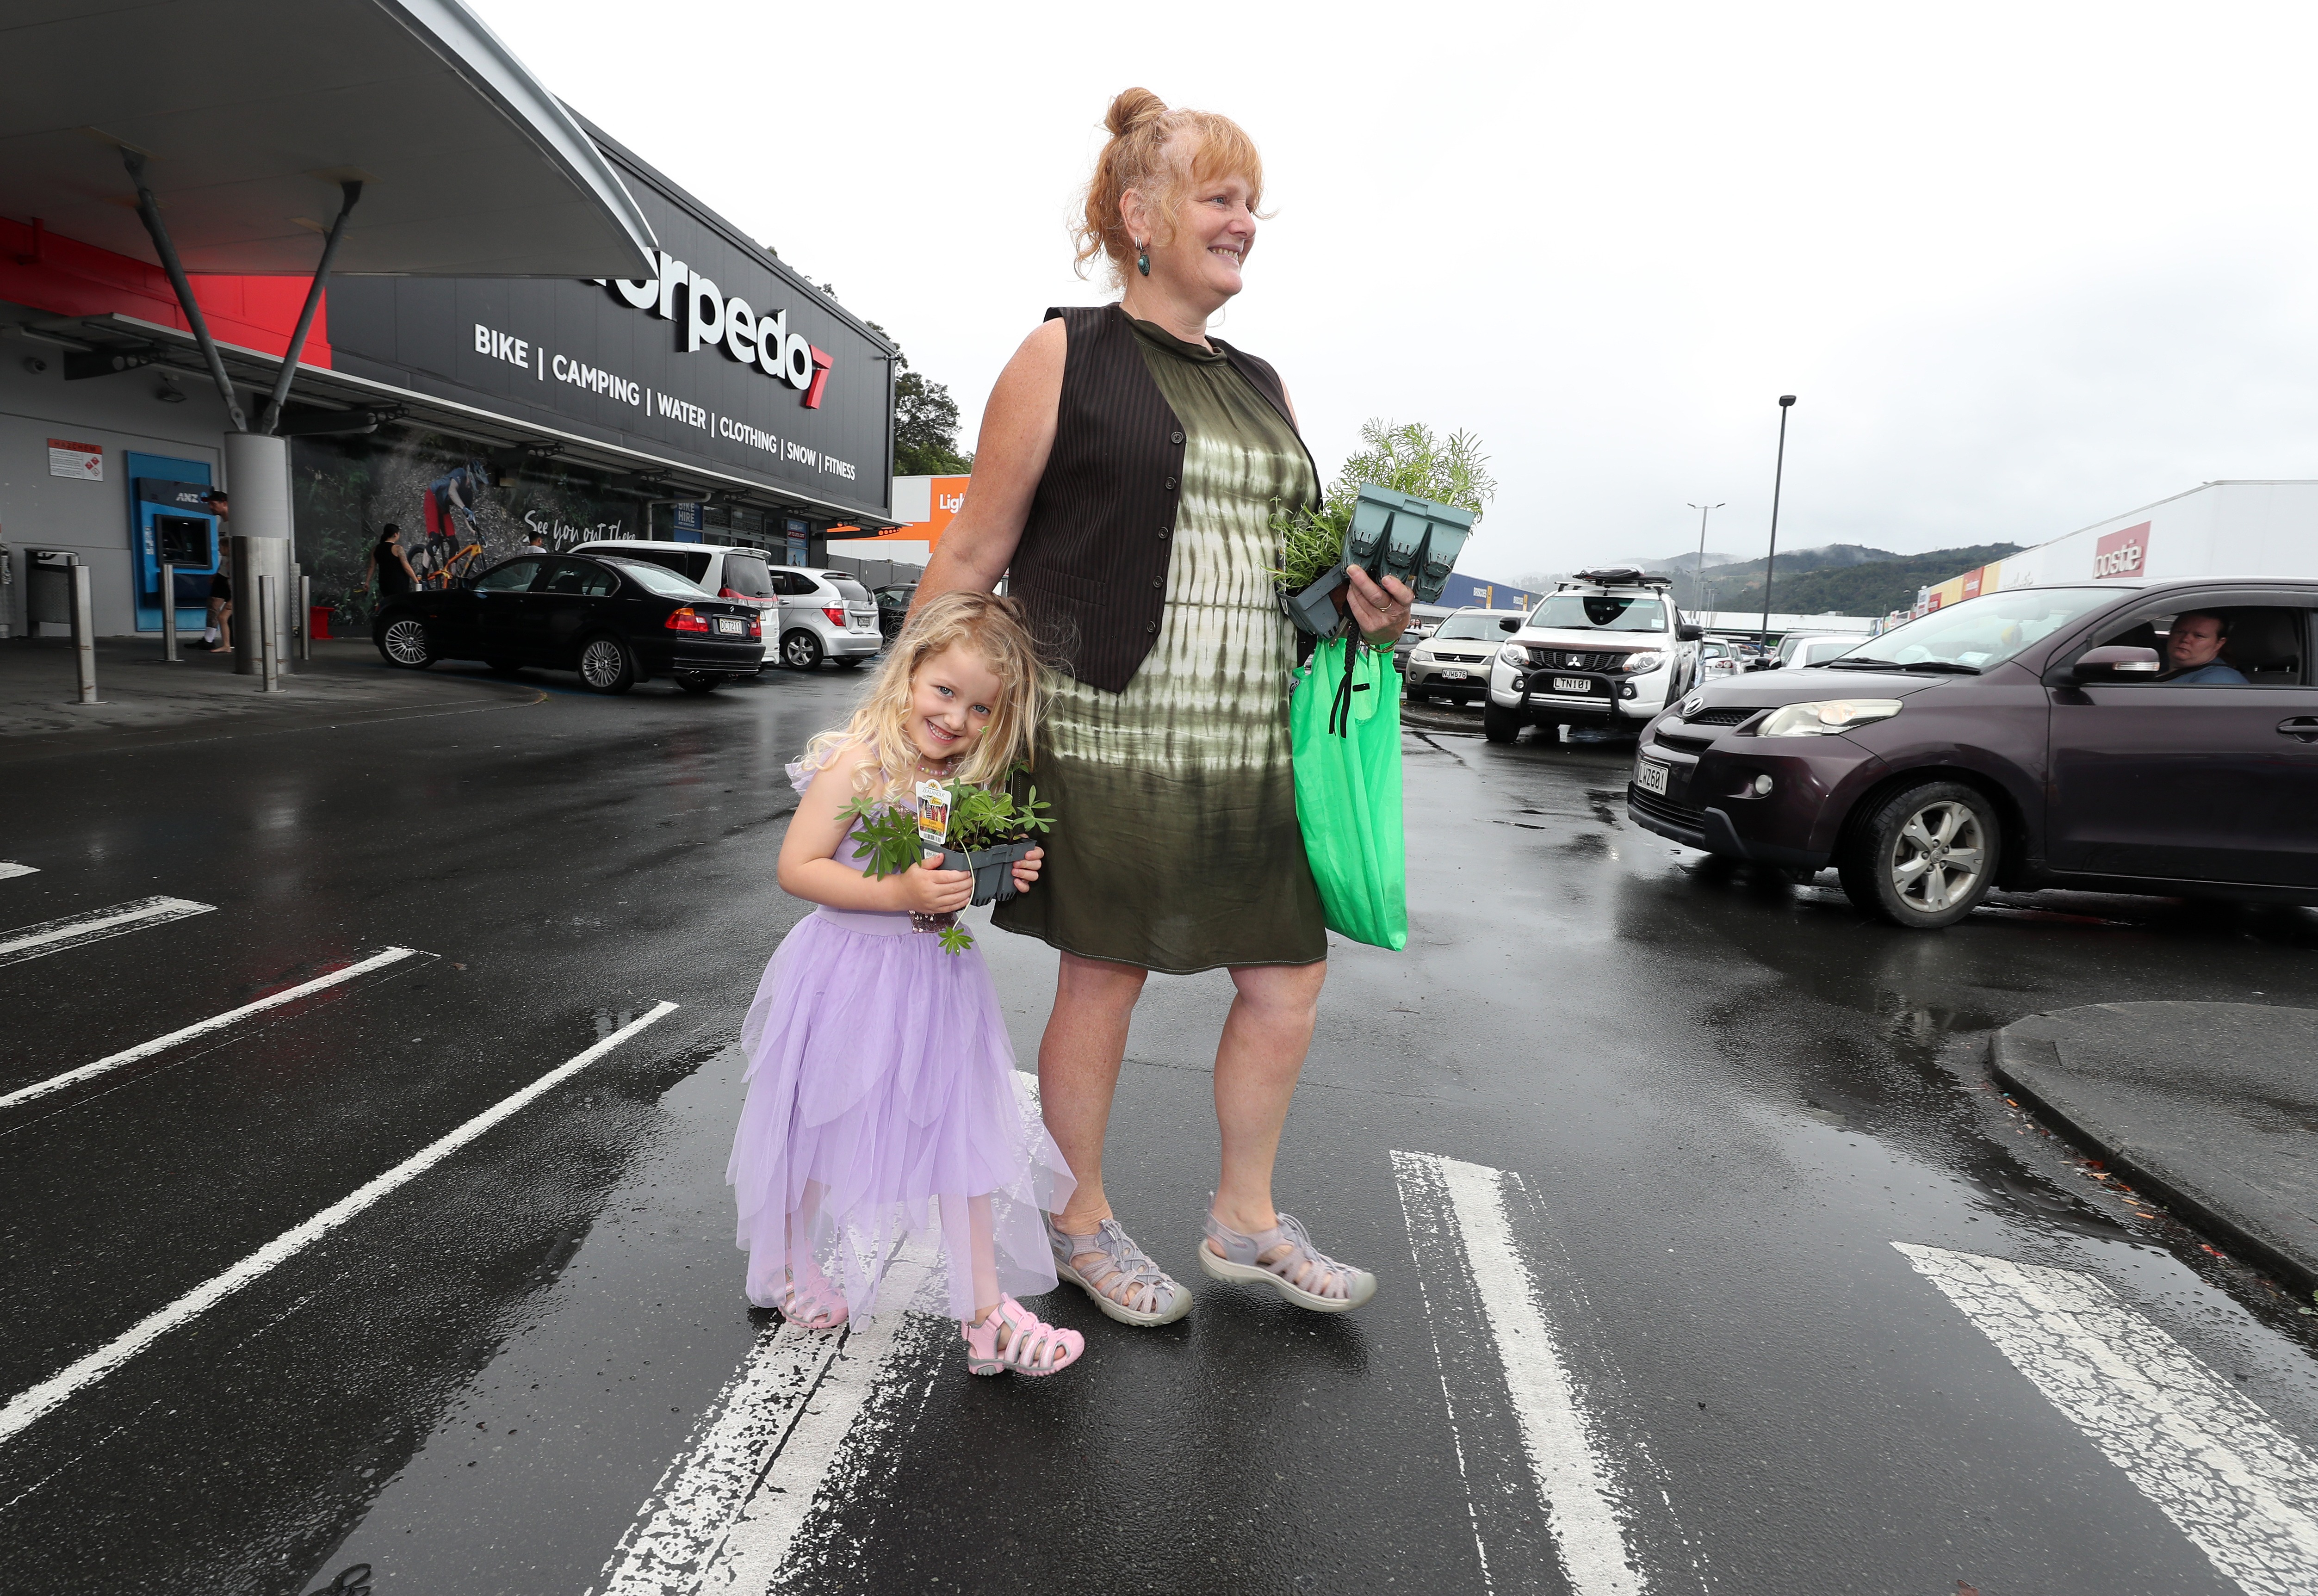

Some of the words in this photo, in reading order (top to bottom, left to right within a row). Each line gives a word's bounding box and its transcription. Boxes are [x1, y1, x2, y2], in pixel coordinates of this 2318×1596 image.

[593, 247, 833, 409] orpedo7
[475, 323, 528, 369] BIKE
[552, 354, 639, 406] CAMPING
[657, 392, 706, 430] WATER
[719, 416, 777, 454] CLOTHING
[787, 441, 816, 467] SNOW
[824, 455, 855, 481] FITNESS
[55, 441, 96, 452] HAZCHEM
[176, 492, 199, 503] ANZ
[678, 503, 694, 513] BIKE
[678, 510, 694, 524] HIRE
[523, 510, 548, 543] See
[553, 519, 579, 551] you
[583, 523, 606, 542] out
[721, 620, 740, 631] DCT211
[1555, 679, 1588, 689] LTN101
